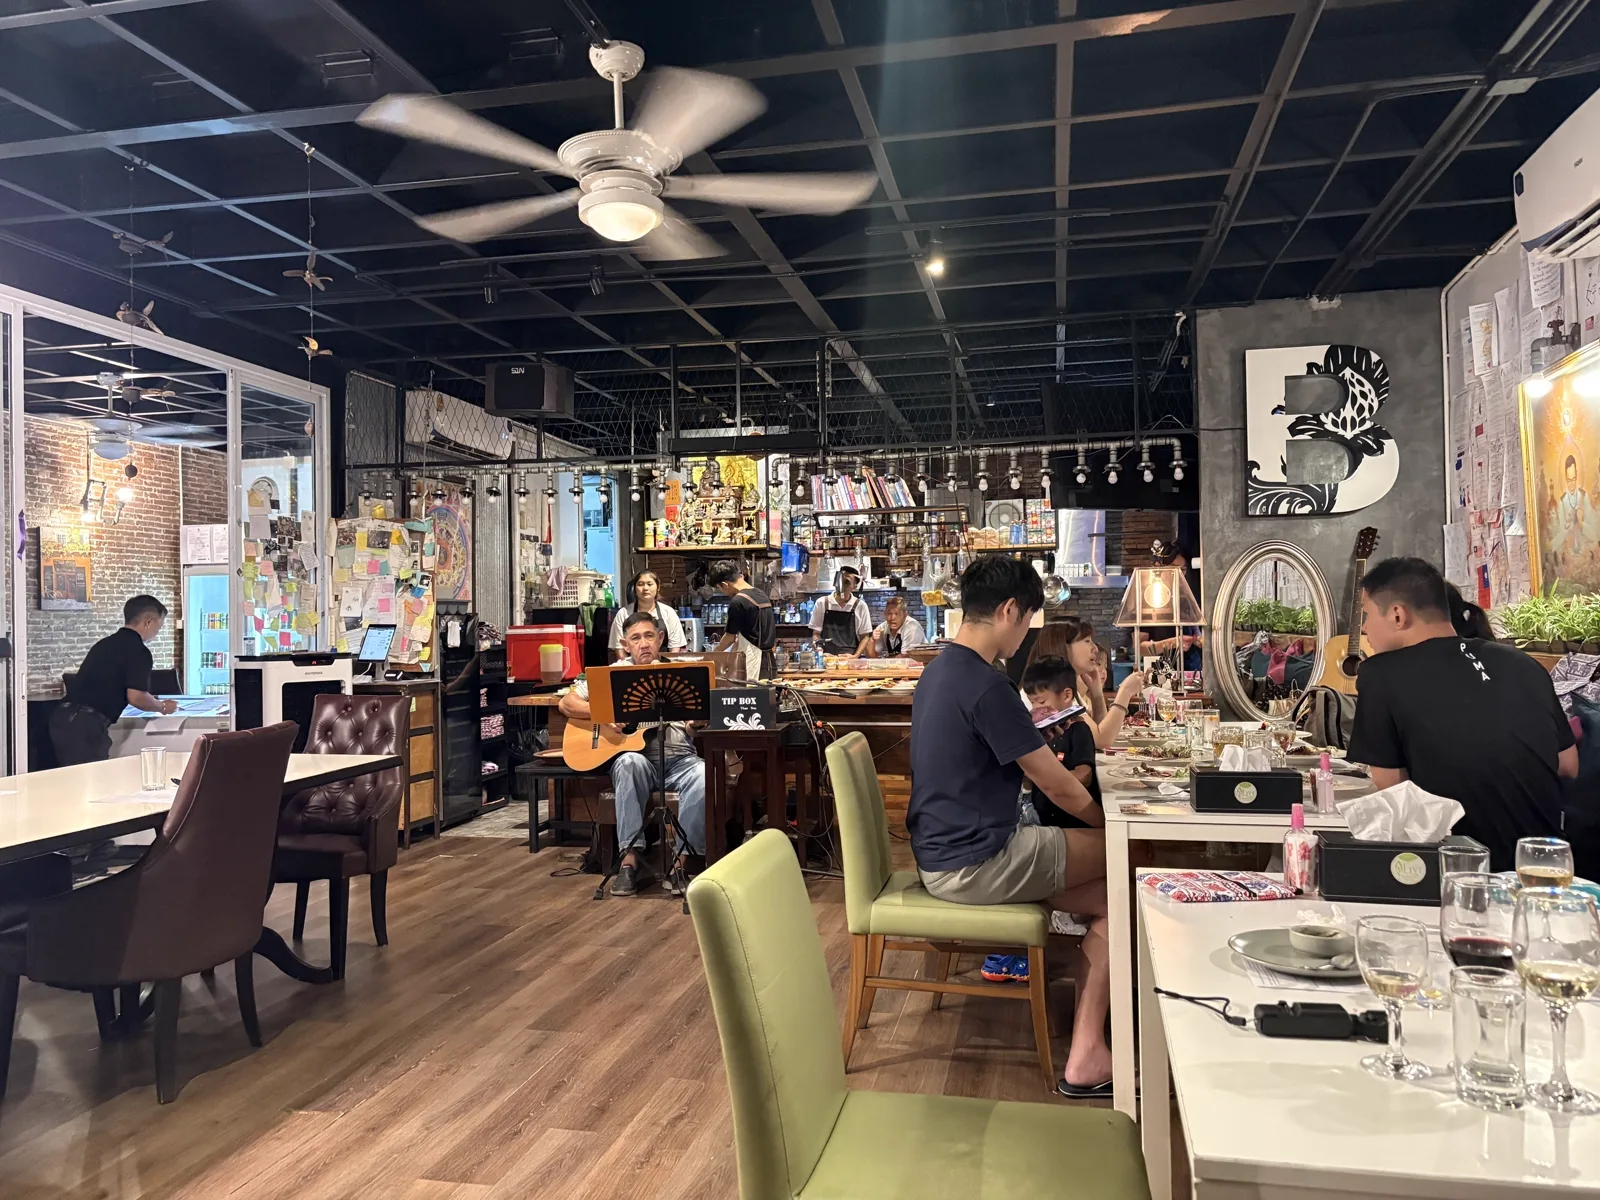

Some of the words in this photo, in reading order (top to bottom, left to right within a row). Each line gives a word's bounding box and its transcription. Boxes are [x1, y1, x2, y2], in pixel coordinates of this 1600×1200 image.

[1460, 642, 1491, 681] PUMA
[721, 697, 737, 705] TIP
[738, 697, 757, 705] BOX
